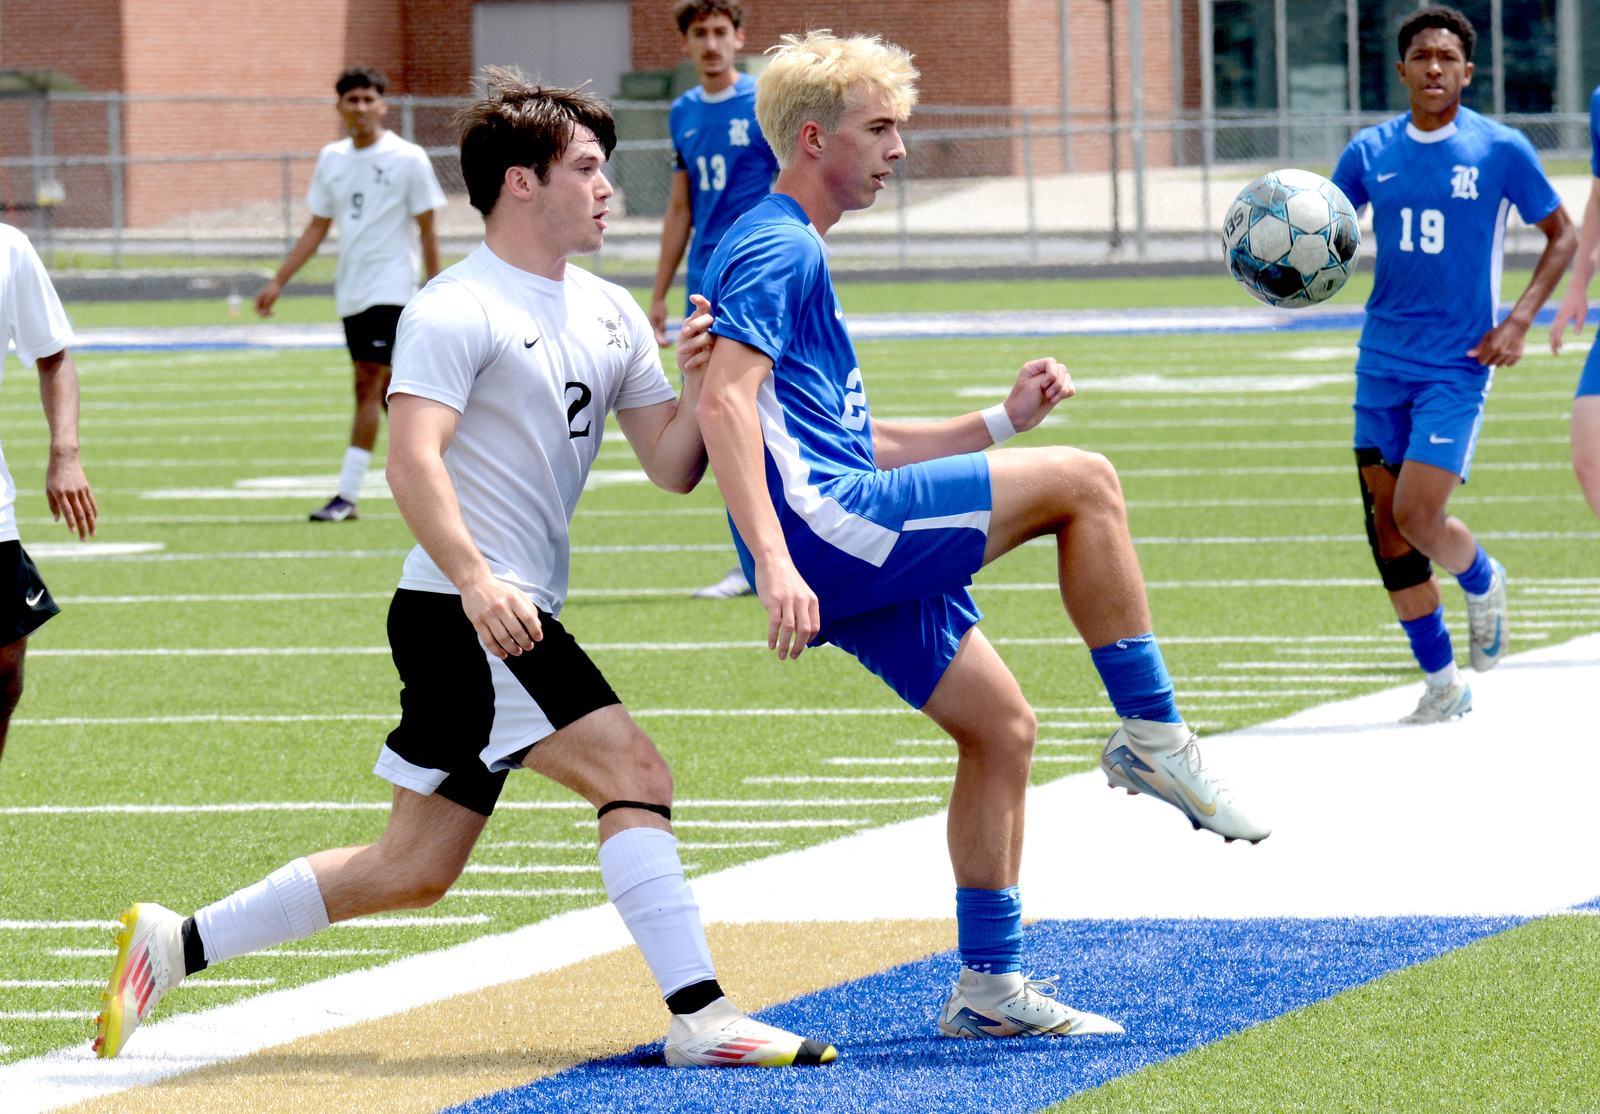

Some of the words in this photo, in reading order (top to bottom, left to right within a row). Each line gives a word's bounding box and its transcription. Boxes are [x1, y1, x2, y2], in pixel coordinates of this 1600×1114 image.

[696, 154, 726, 191] 13
[1451, 165, 1479, 200] R
[351, 192, 364, 220] 9
[1400, 207, 1445, 254] 19
[564, 382, 592, 439] 2
[841, 367, 867, 431] 2
